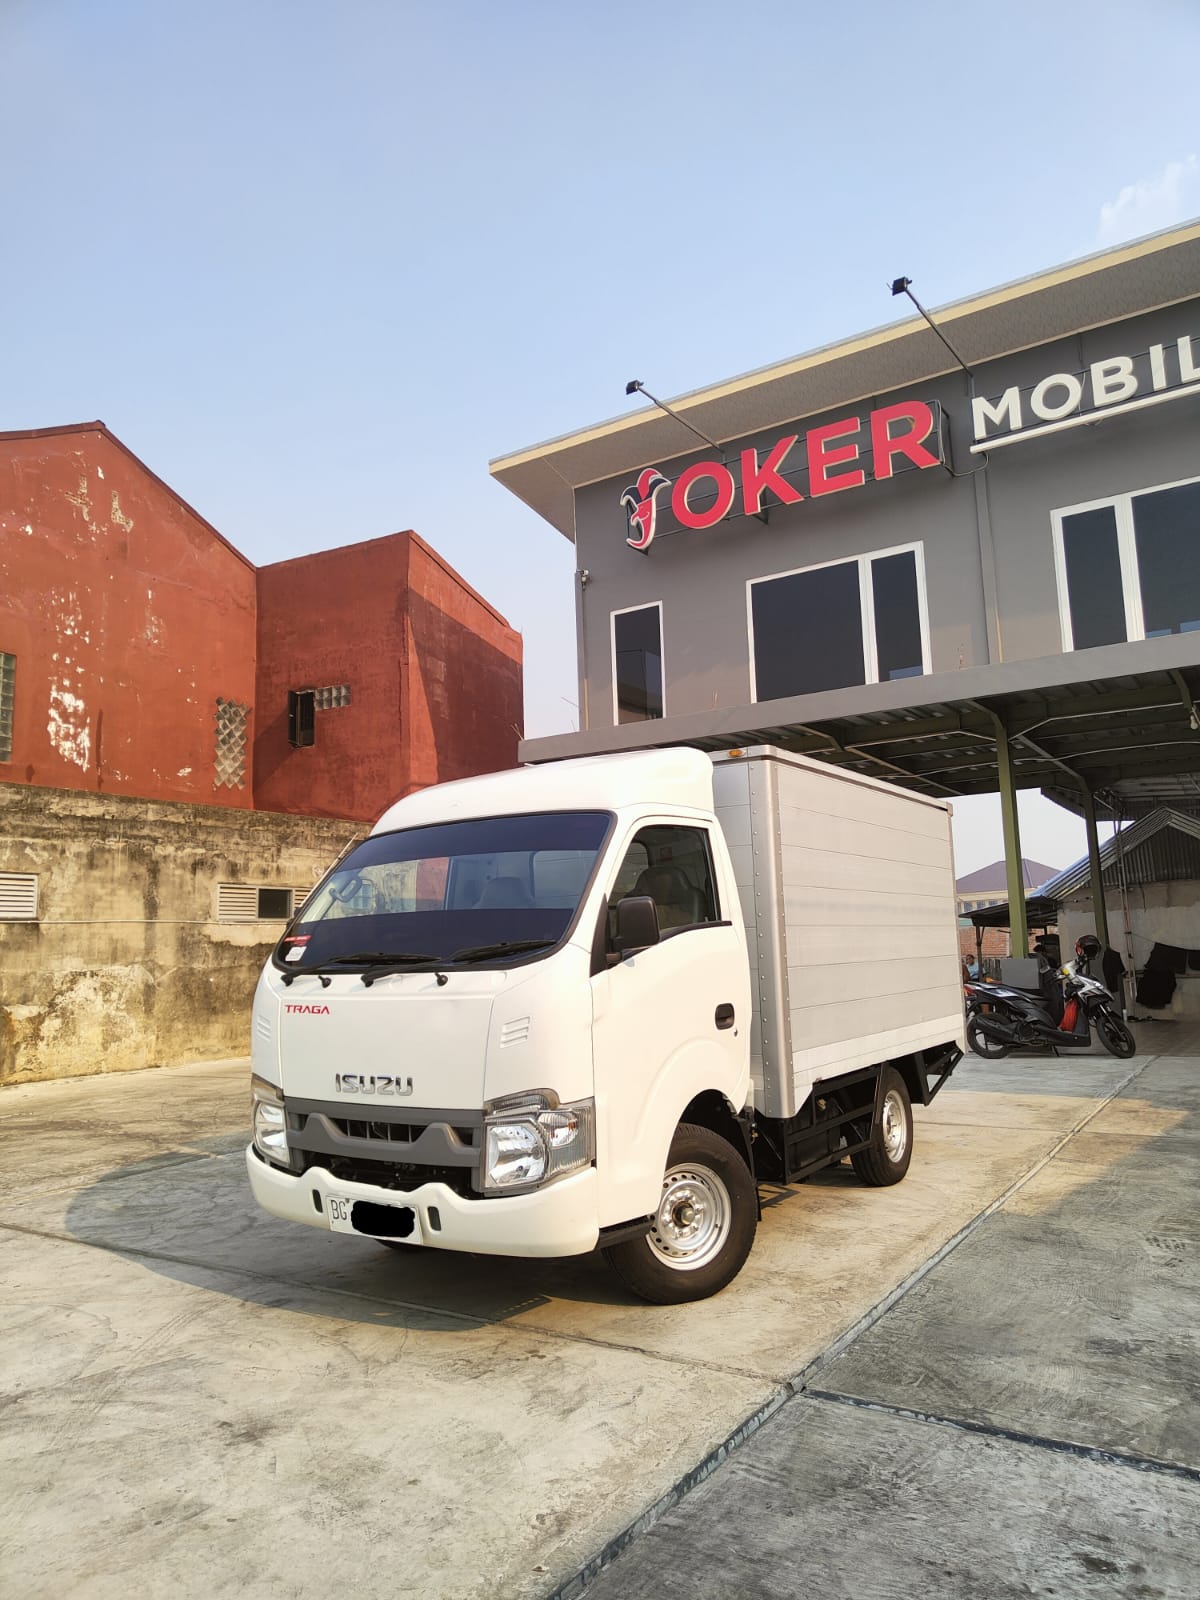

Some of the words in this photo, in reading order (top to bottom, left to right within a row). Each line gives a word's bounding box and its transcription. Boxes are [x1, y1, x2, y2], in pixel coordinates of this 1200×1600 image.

[971, 334, 1200, 441] MOBIL
[284, 1004, 330, 1015] TRAGA
[335, 1073, 414, 1097] ISUZU
[330, 1199, 348, 1221] BG
